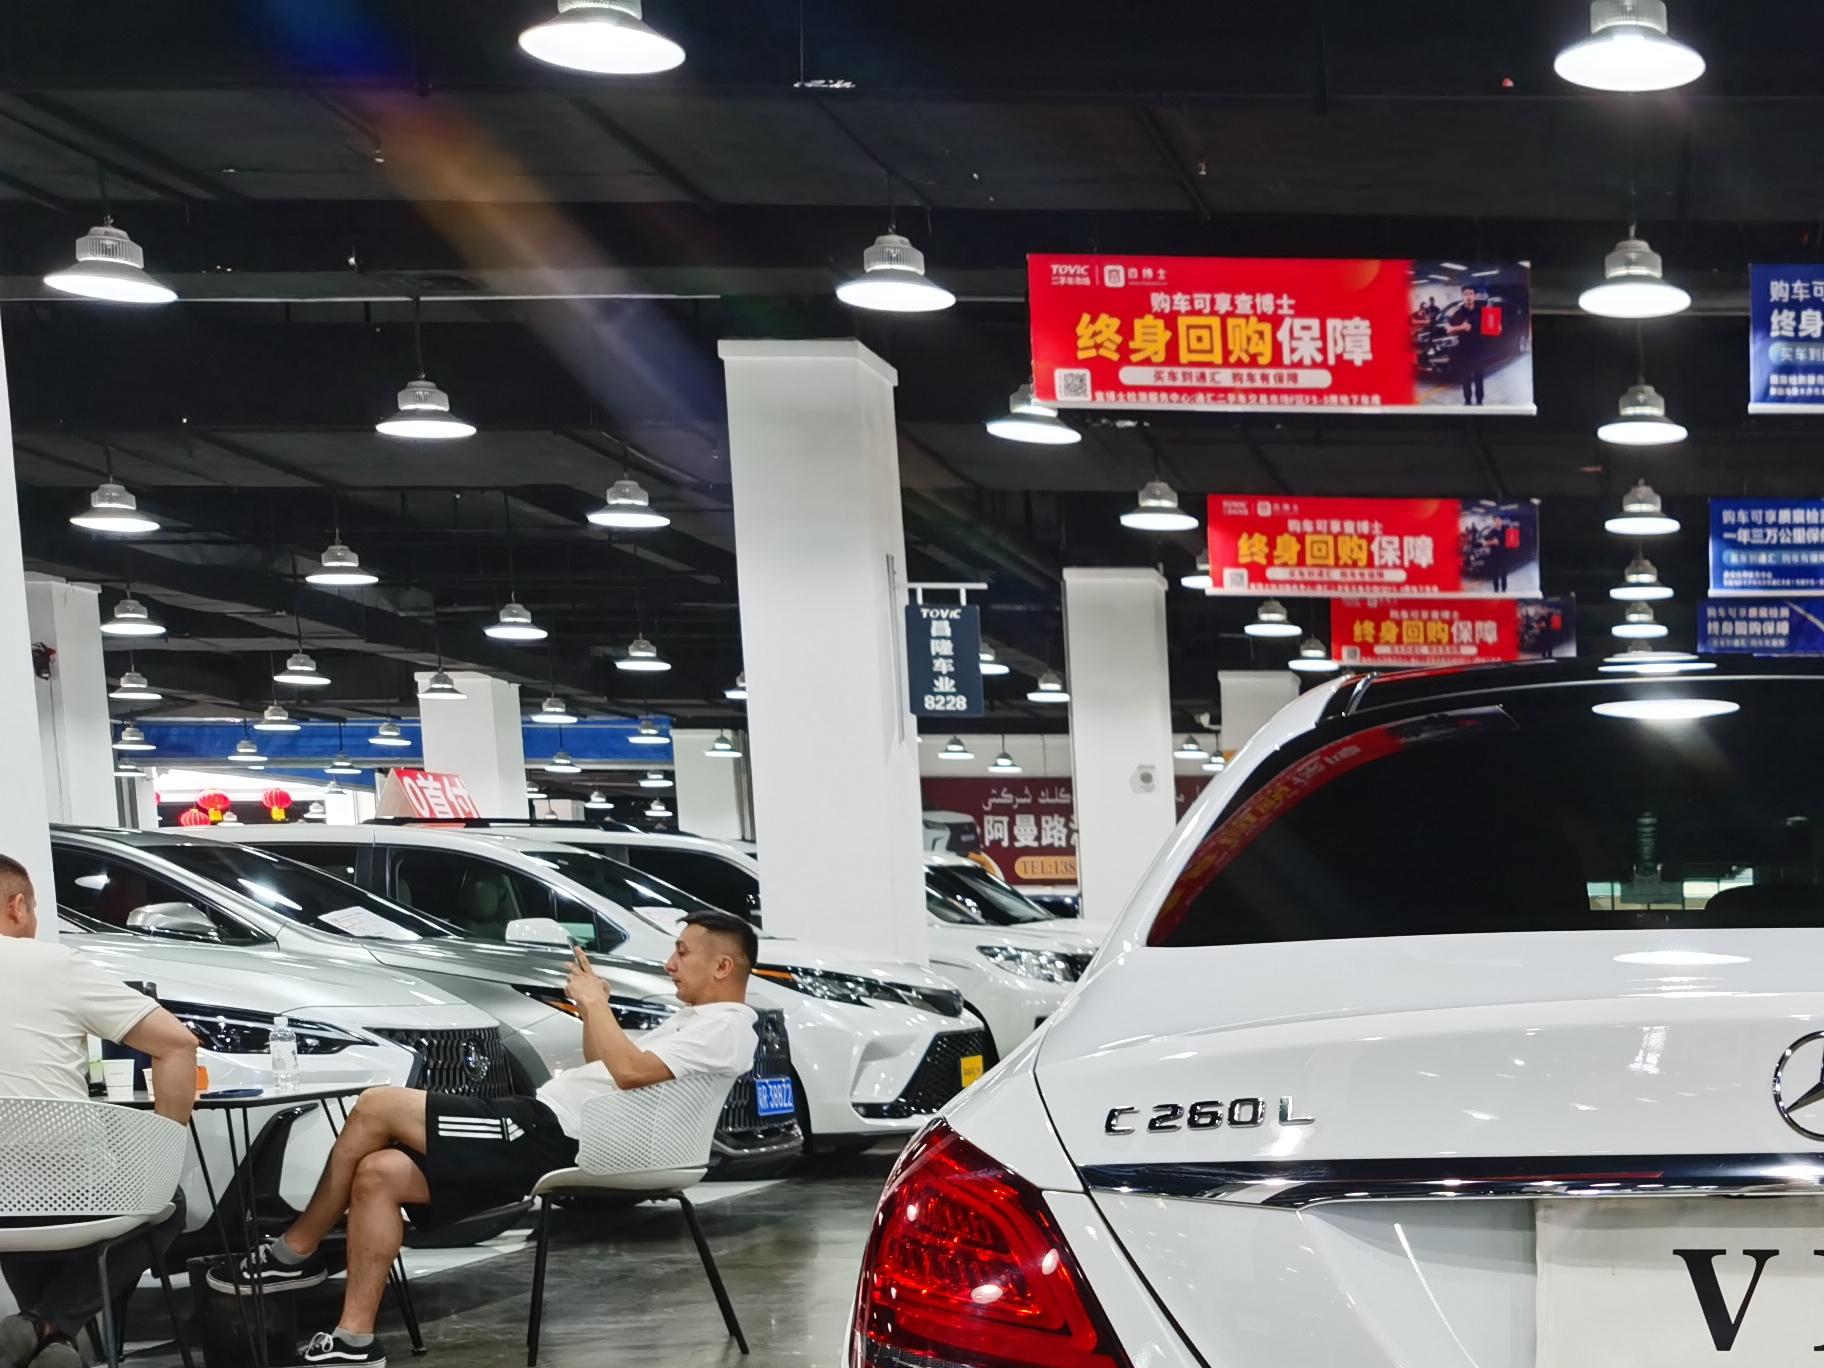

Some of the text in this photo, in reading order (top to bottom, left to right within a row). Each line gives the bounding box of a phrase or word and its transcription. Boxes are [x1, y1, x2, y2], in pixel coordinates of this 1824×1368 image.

[1050, 264, 1090, 276] TOVIC
[1075, 312, 1374, 367] 终身回购保障
[1153, 369, 1299, 386] 买车到通汇 购车有保障
[1237, 532, 1435, 568] 终身回购保障
[920, 608, 962, 619] TOVIC
[1352, 620, 1498, 645] 终身回购保障
[923, 694, 968, 712] 8228
[1104, 1095, 1316, 1136] C 260 L
